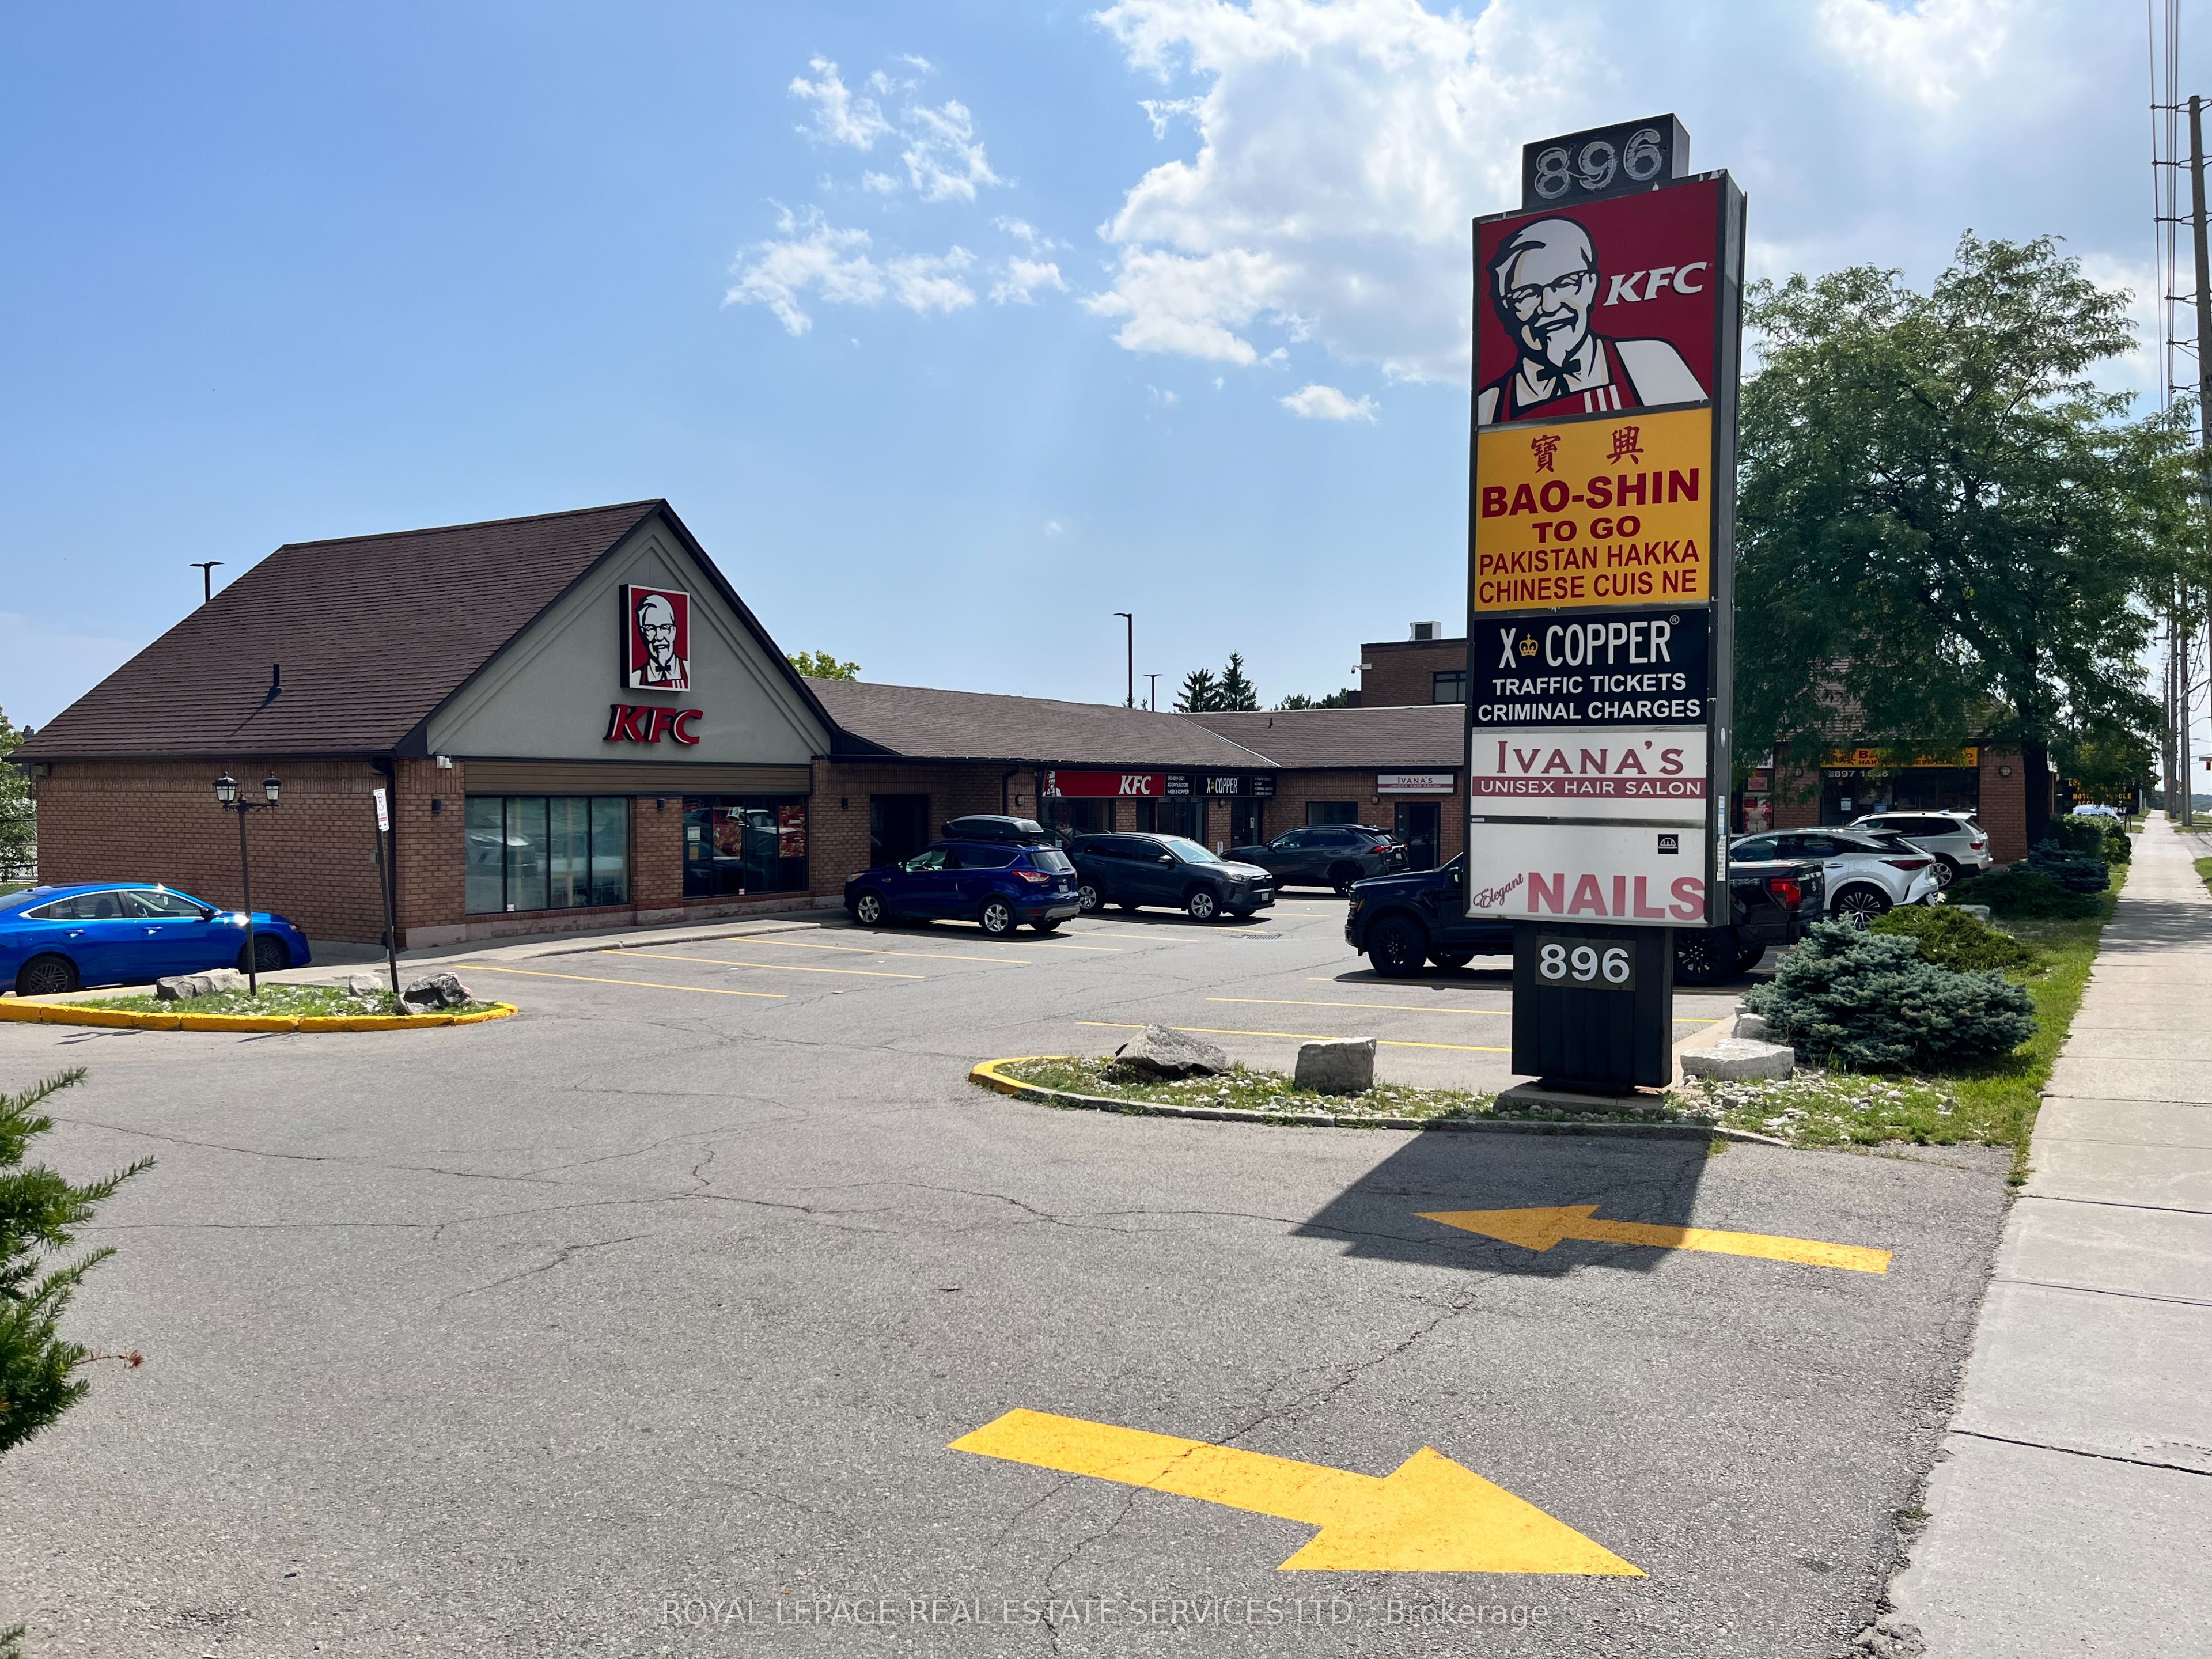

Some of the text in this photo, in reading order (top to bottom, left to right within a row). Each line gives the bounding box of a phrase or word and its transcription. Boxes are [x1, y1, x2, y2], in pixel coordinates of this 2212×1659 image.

[1534, 128, 1662, 199] 896
[1603, 262, 1707, 306] KFC
[1481, 468, 1700, 518] BAO-SHIN
[1532, 515, 1641, 544] TO GO
[1479, 539, 1700, 576] PAKISTAN HAKKA
[1479, 575, 1585, 604] CHINESE
[1499, 628, 1516, 669] X
[1492, 672, 1687, 696] TRAFFIC TICKETS
[603, 704, 703, 744] KFC
[1478, 699, 1701, 722] CRIMINAL CHARGES
[1118, 775, 1152, 794] KFC
[1206, 777, 1211, 794] X
[1480, 781, 1701, 796] UNISEX HAIR SALON
[1473, 872, 1705, 921] Elegant NAILS
[1539, 944, 1630, 983] 896
